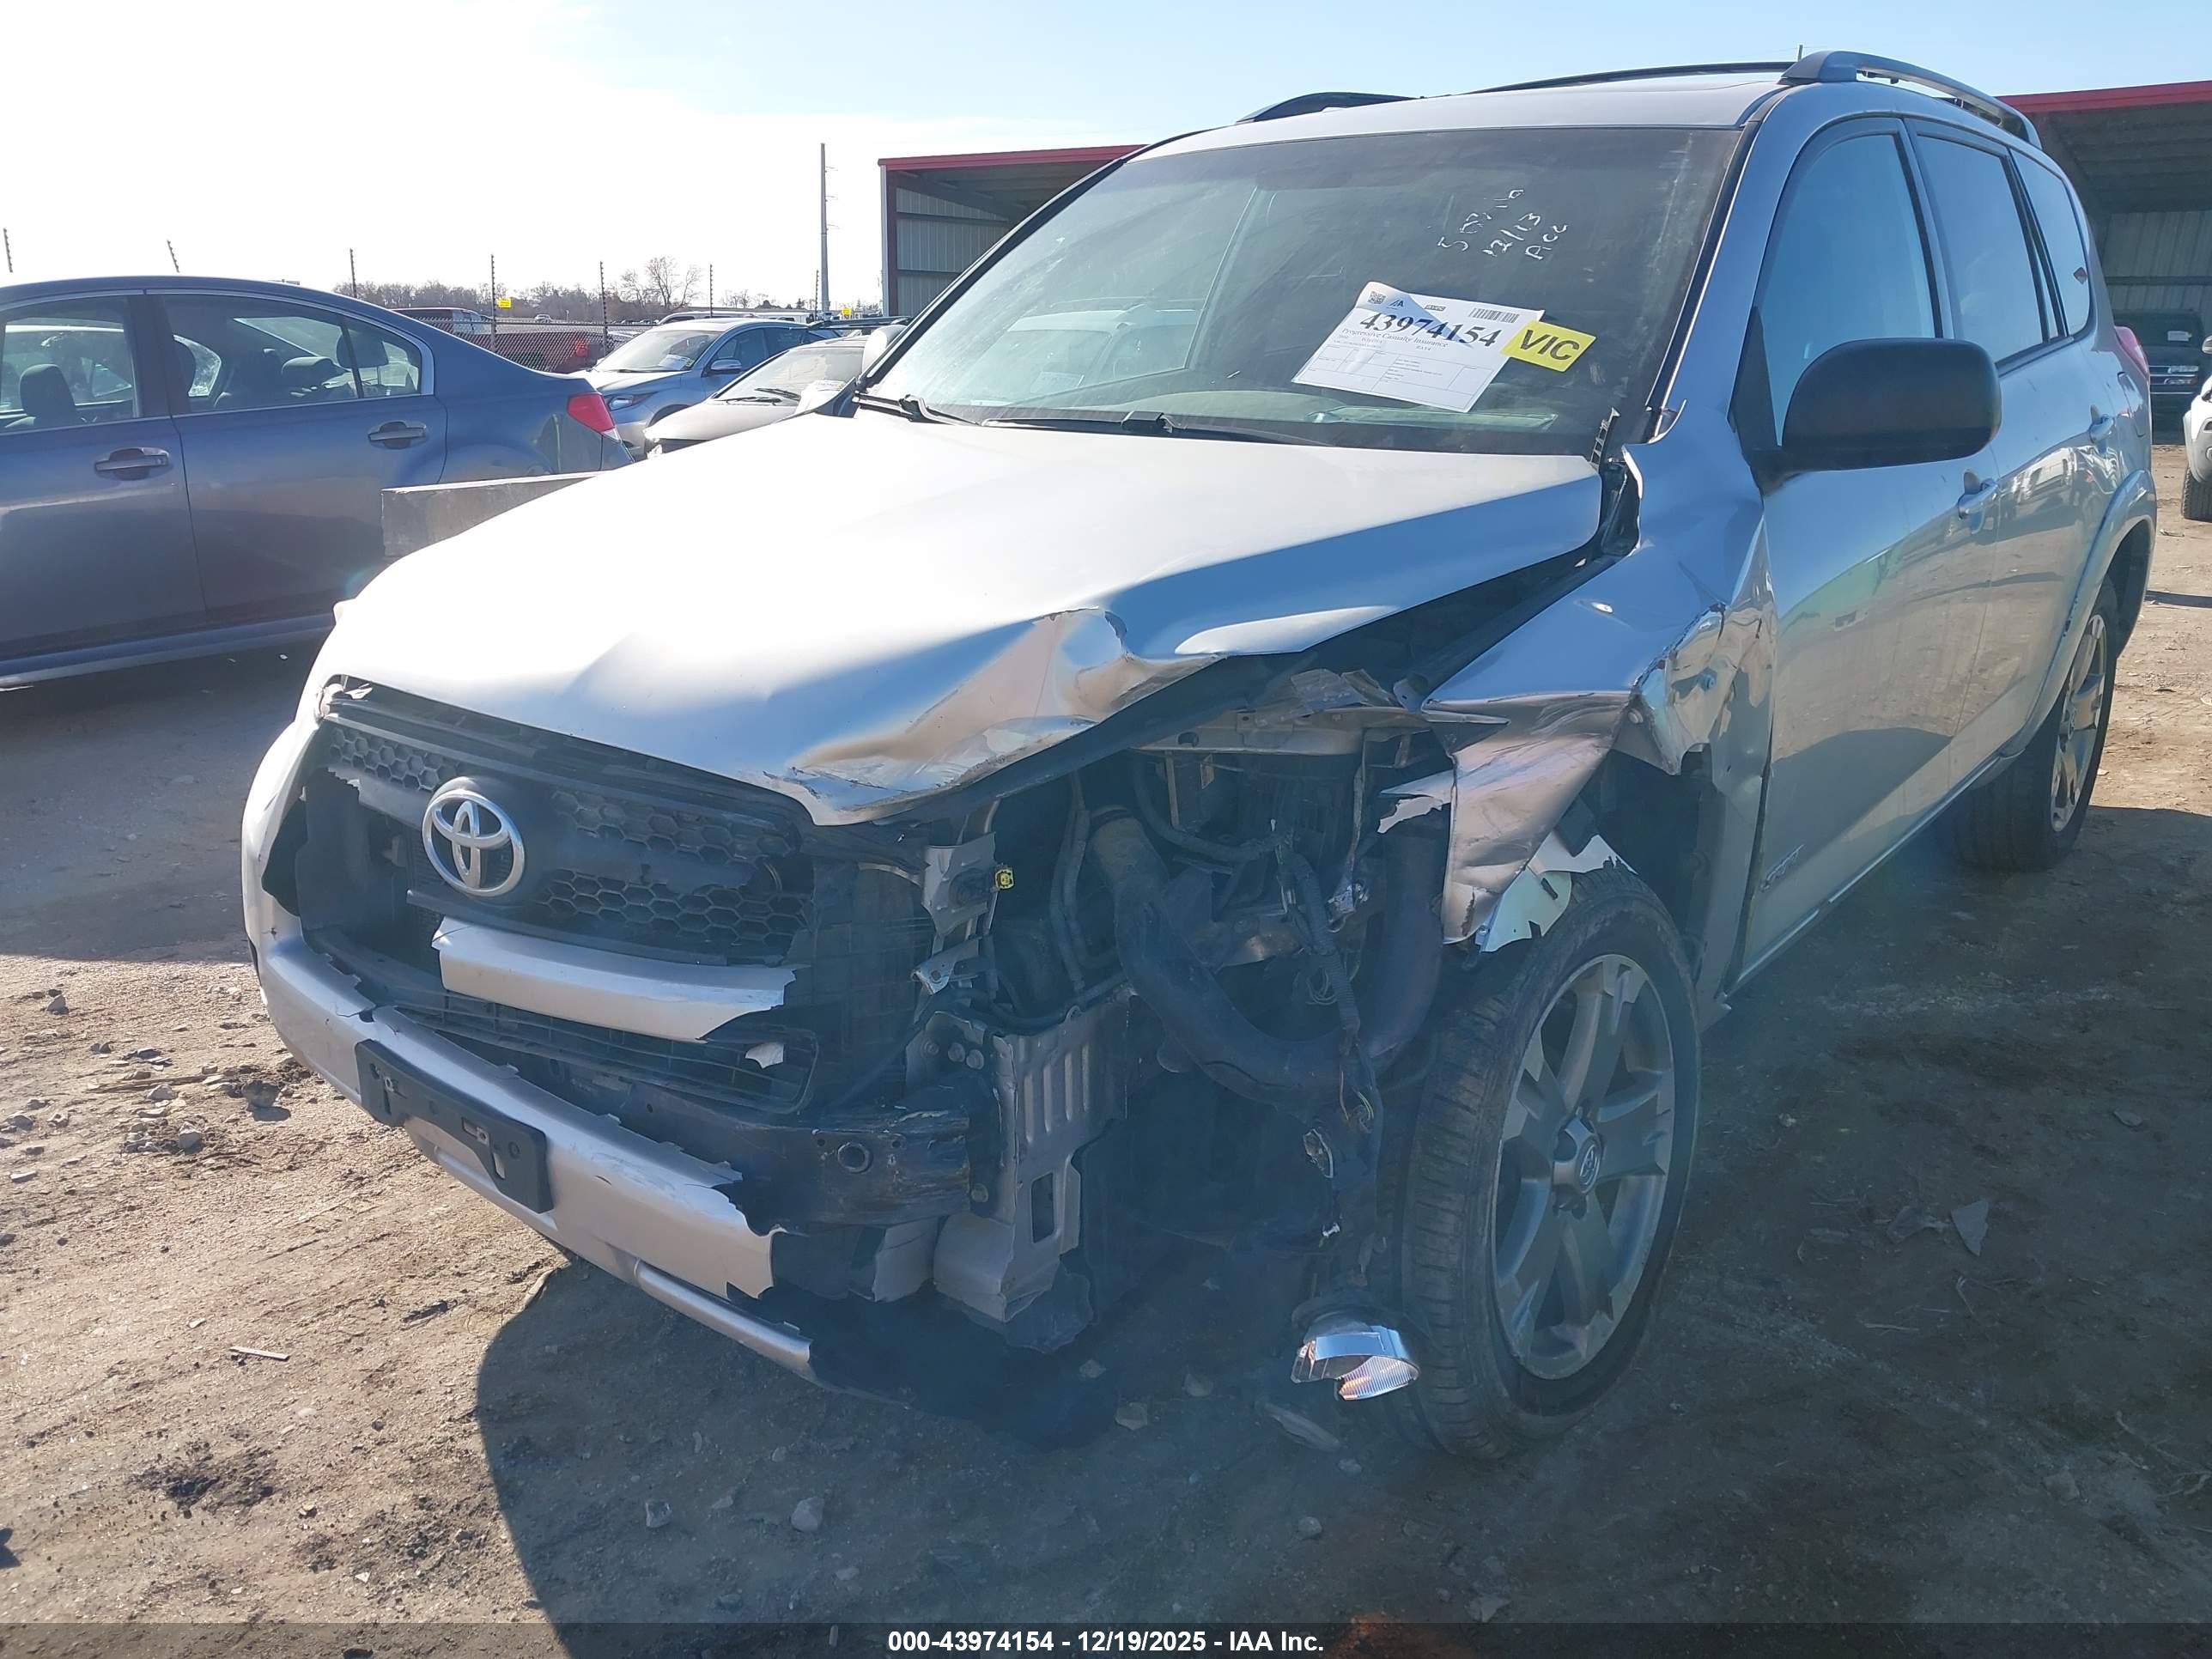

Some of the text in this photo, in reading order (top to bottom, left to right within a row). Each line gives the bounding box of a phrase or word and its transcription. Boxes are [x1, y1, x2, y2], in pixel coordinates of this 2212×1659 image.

[1359, 312, 1503, 347] 43974154
[1382, 333, 1413, 343] Casualty
[1413, 337, 1449, 348] Insurance
[1520, 329, 1580, 361] VIC
